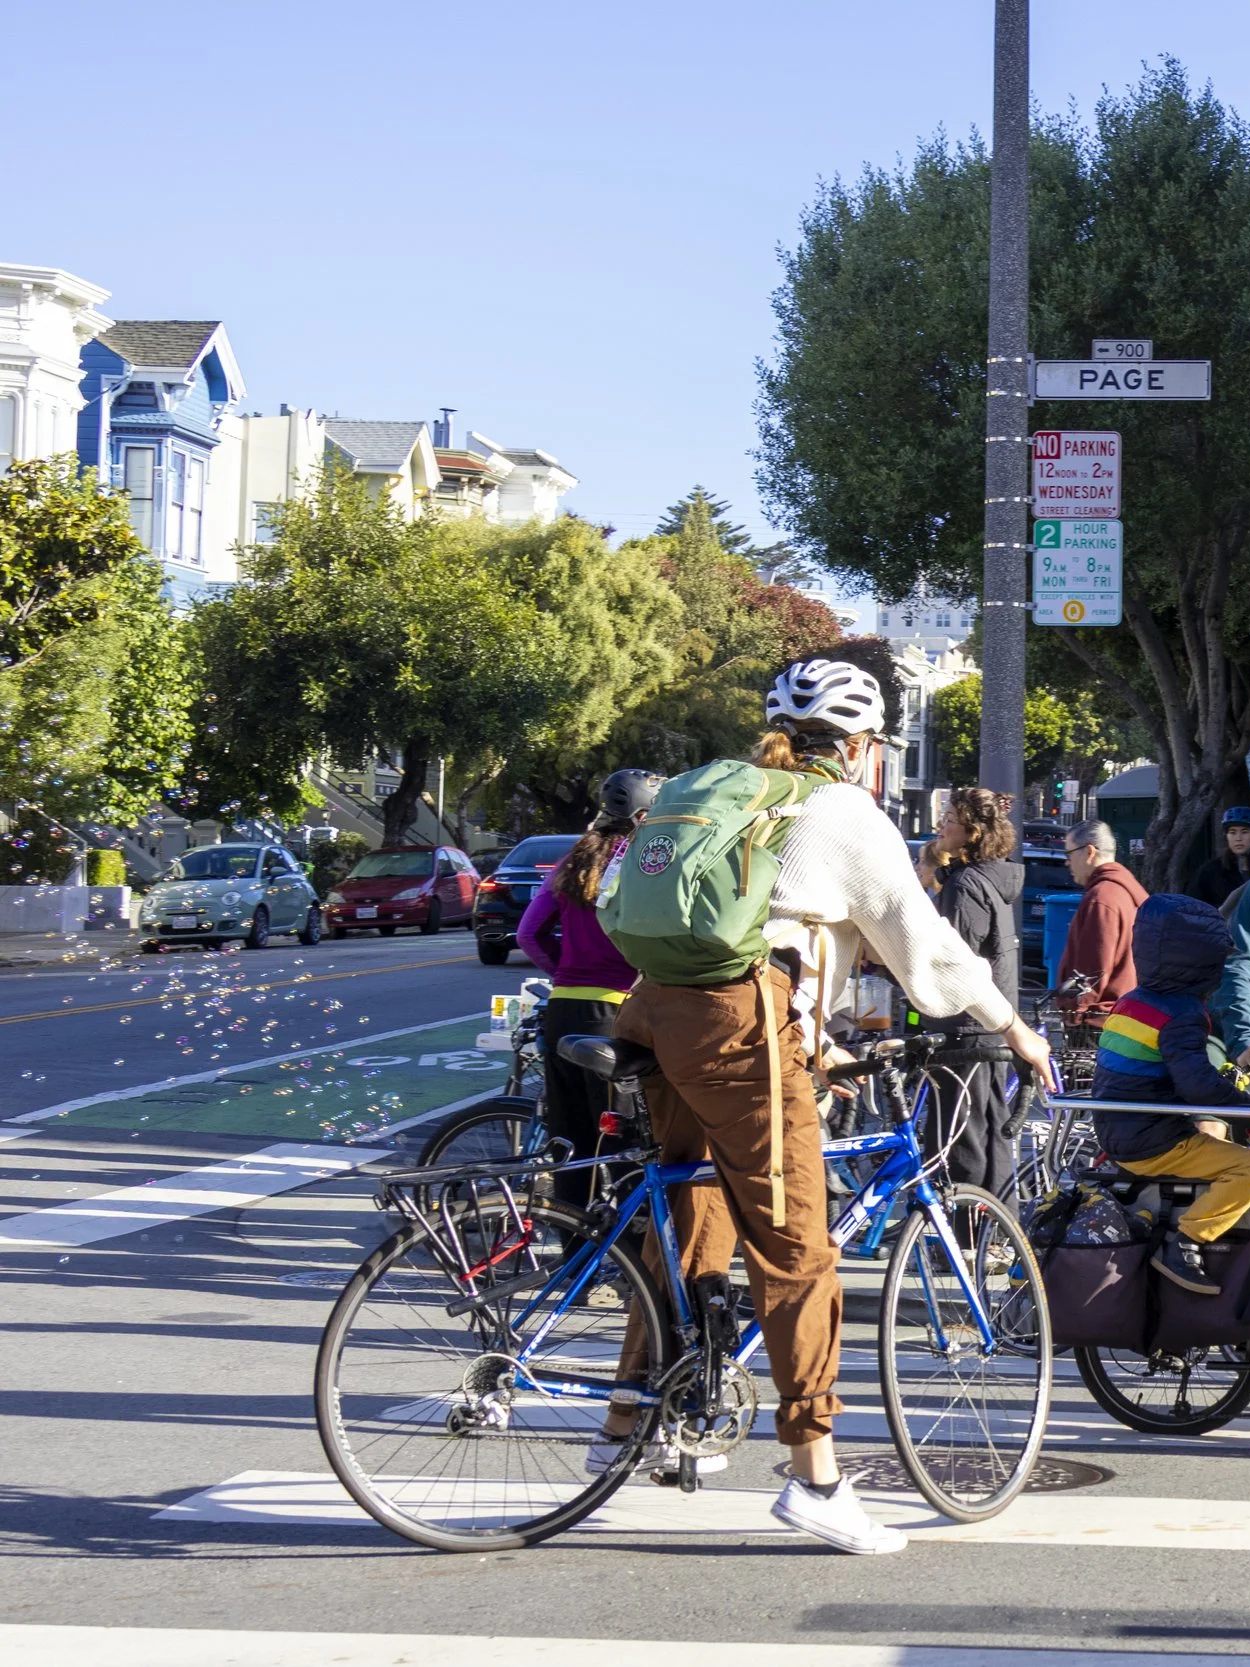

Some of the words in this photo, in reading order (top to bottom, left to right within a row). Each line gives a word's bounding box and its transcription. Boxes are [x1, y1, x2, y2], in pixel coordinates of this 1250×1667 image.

[1115, 343, 1145, 357] 900
[1079, 369, 1165, 390] PAGE
[1036, 434, 1059, 457] NO
[1064, 440, 1116, 457] PARKING
[1038, 485, 1114, 499] WEDNESDAY
[1040, 506, 1070, 515] STREET
[1040, 524, 1056, 546] 2
[1073, 523, 1108, 535] HOUR
[1064, 538, 1117, 549] PARKING
[1042, 576, 1067, 587] MON
[1093, 576, 1112, 587] FRI
[648, 838, 673, 850] PEDAL
